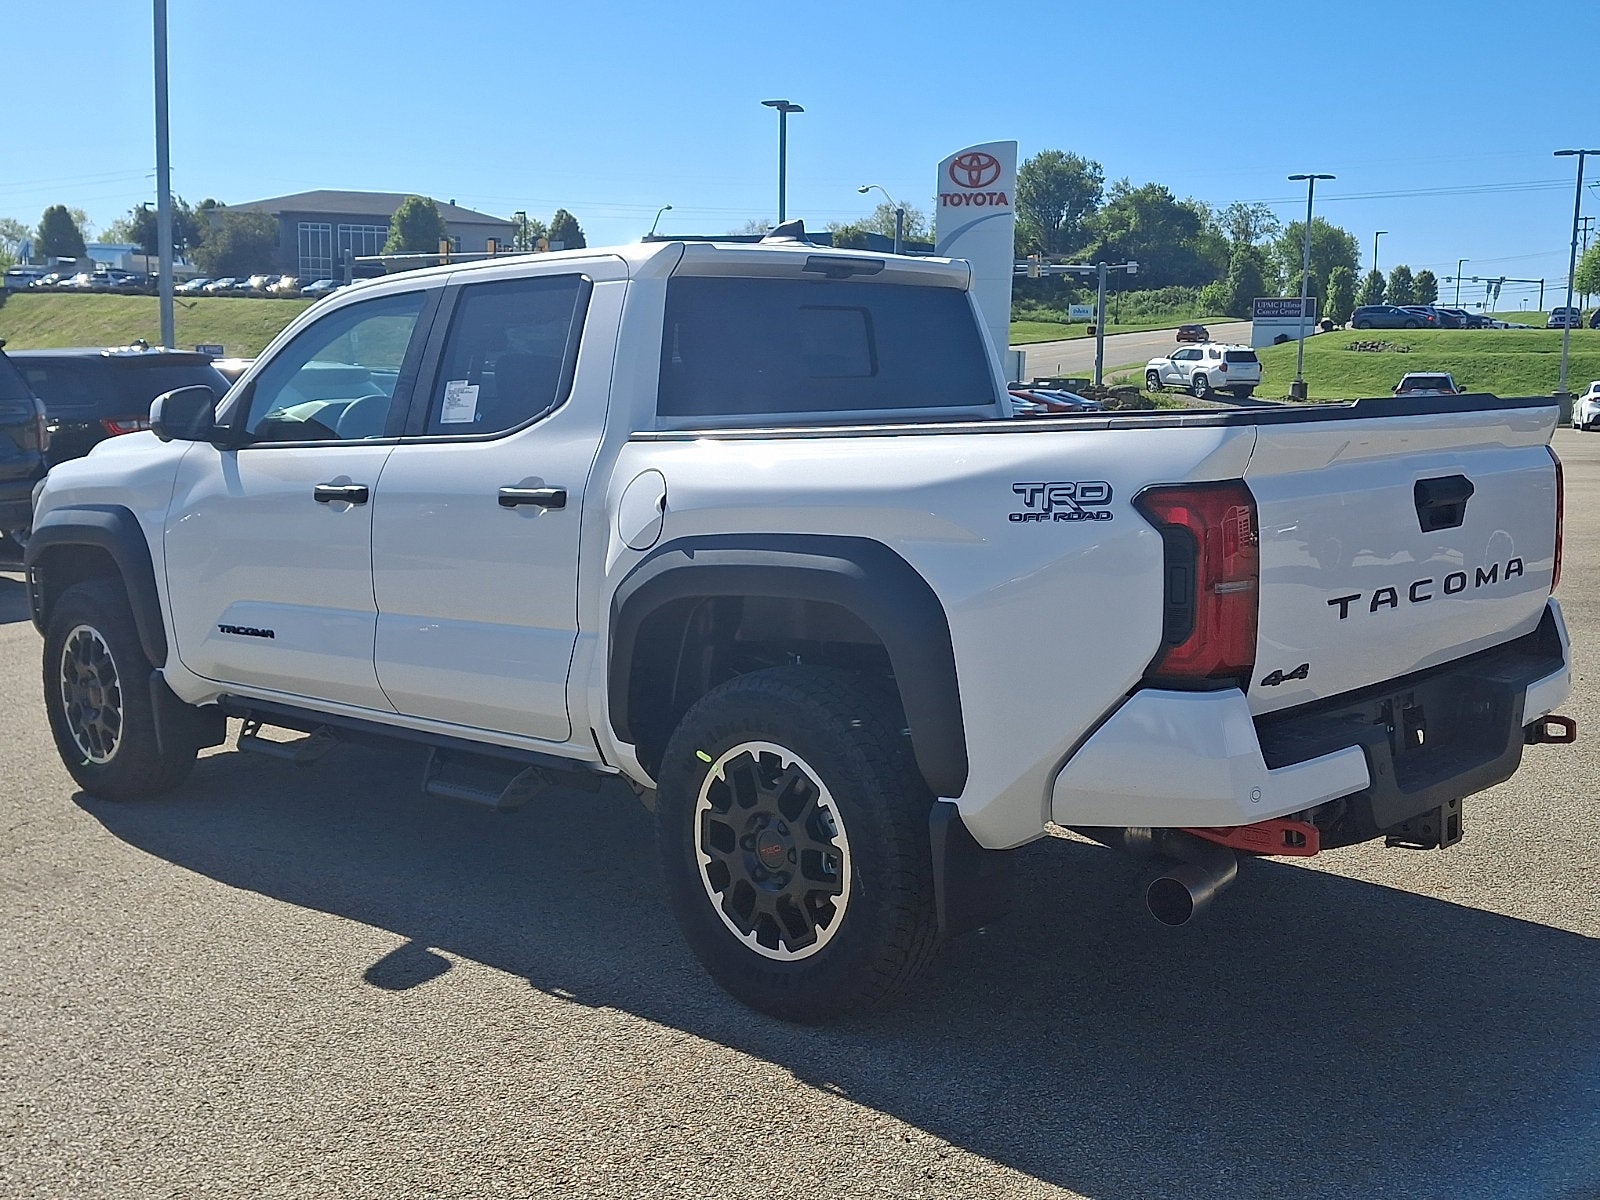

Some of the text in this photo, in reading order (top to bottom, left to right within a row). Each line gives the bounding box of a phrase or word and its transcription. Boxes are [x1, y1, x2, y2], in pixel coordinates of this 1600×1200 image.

[940, 192, 1008, 207] TOYOTA
[1012, 481, 1113, 513] TRD
[1009, 511, 1113, 522] OFF ROAD
[1327, 557, 1524, 620] TACOMA
[217, 624, 275, 639] TACOMA
